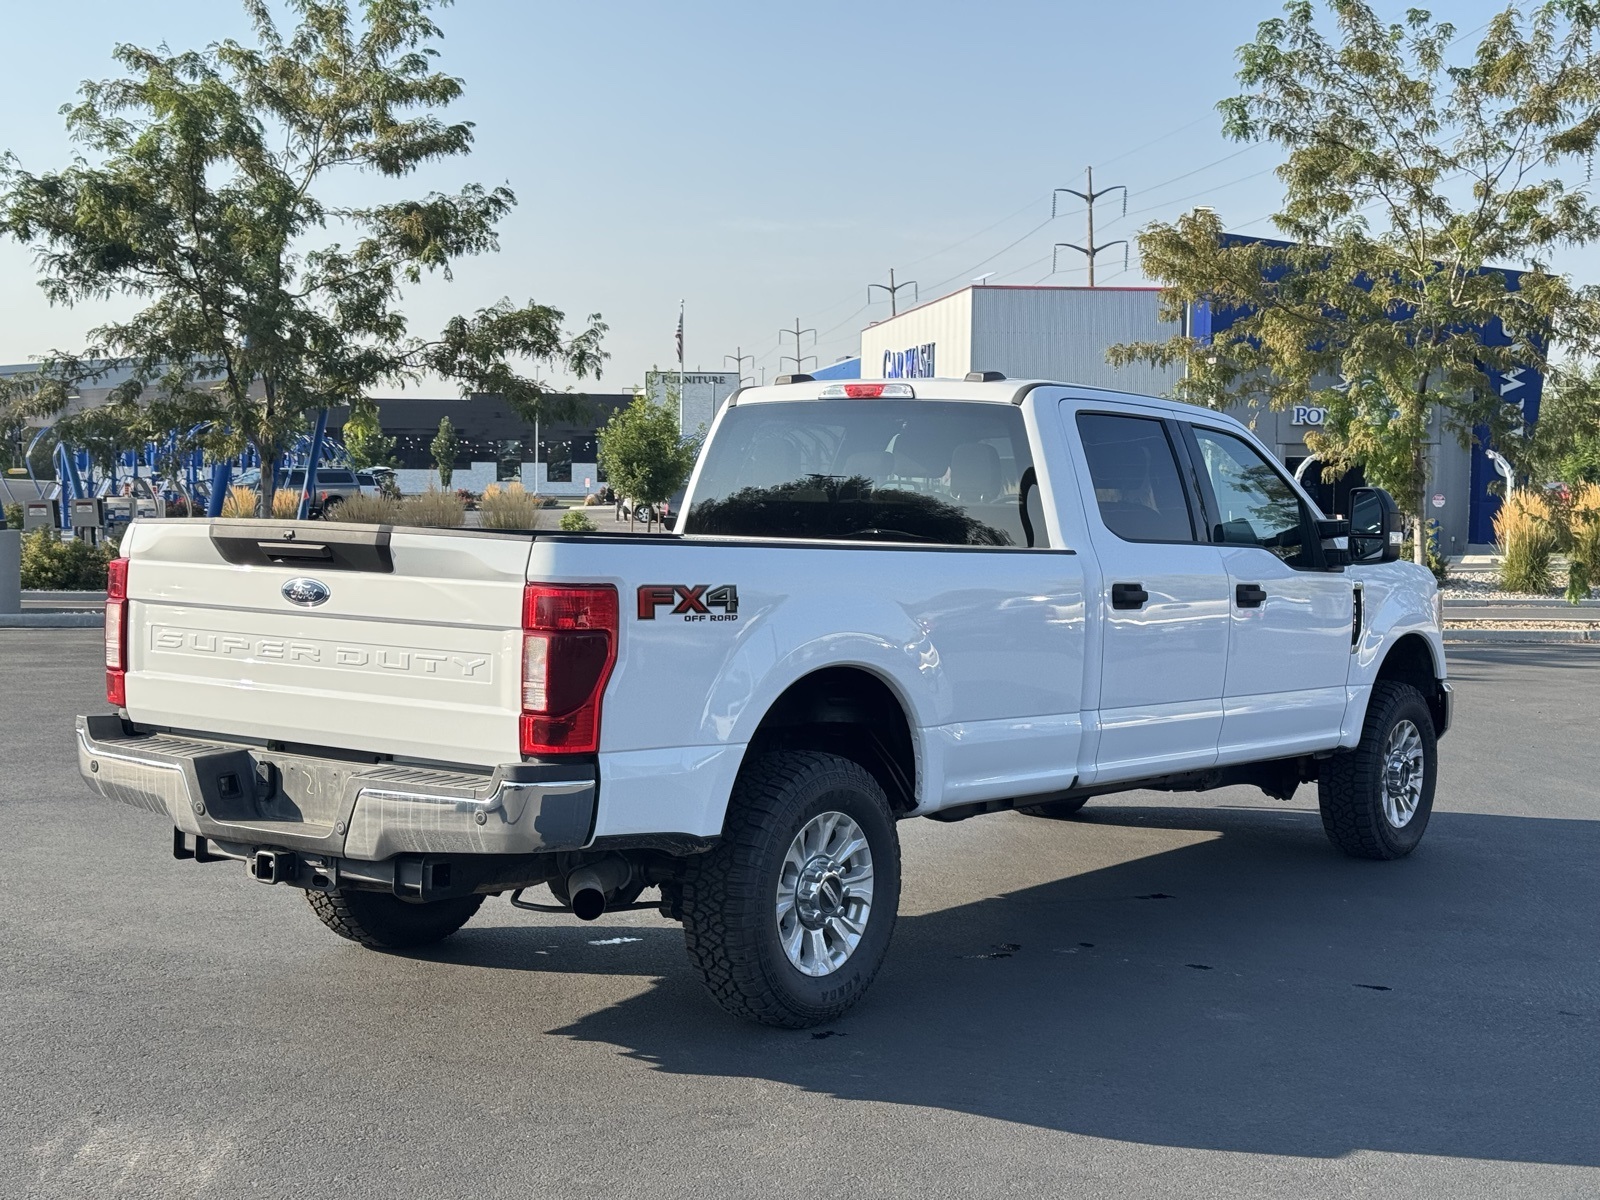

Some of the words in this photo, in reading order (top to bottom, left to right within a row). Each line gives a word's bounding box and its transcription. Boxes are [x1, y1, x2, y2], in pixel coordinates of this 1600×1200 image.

[883, 350, 904, 378] CAR
[904, 342, 936, 378] WASH
[287, 579, 320, 602] Ford
[637, 584, 739, 620] FX4
[156, 630, 321, 663] SUPER
[336, 646, 486, 677] DUTY
